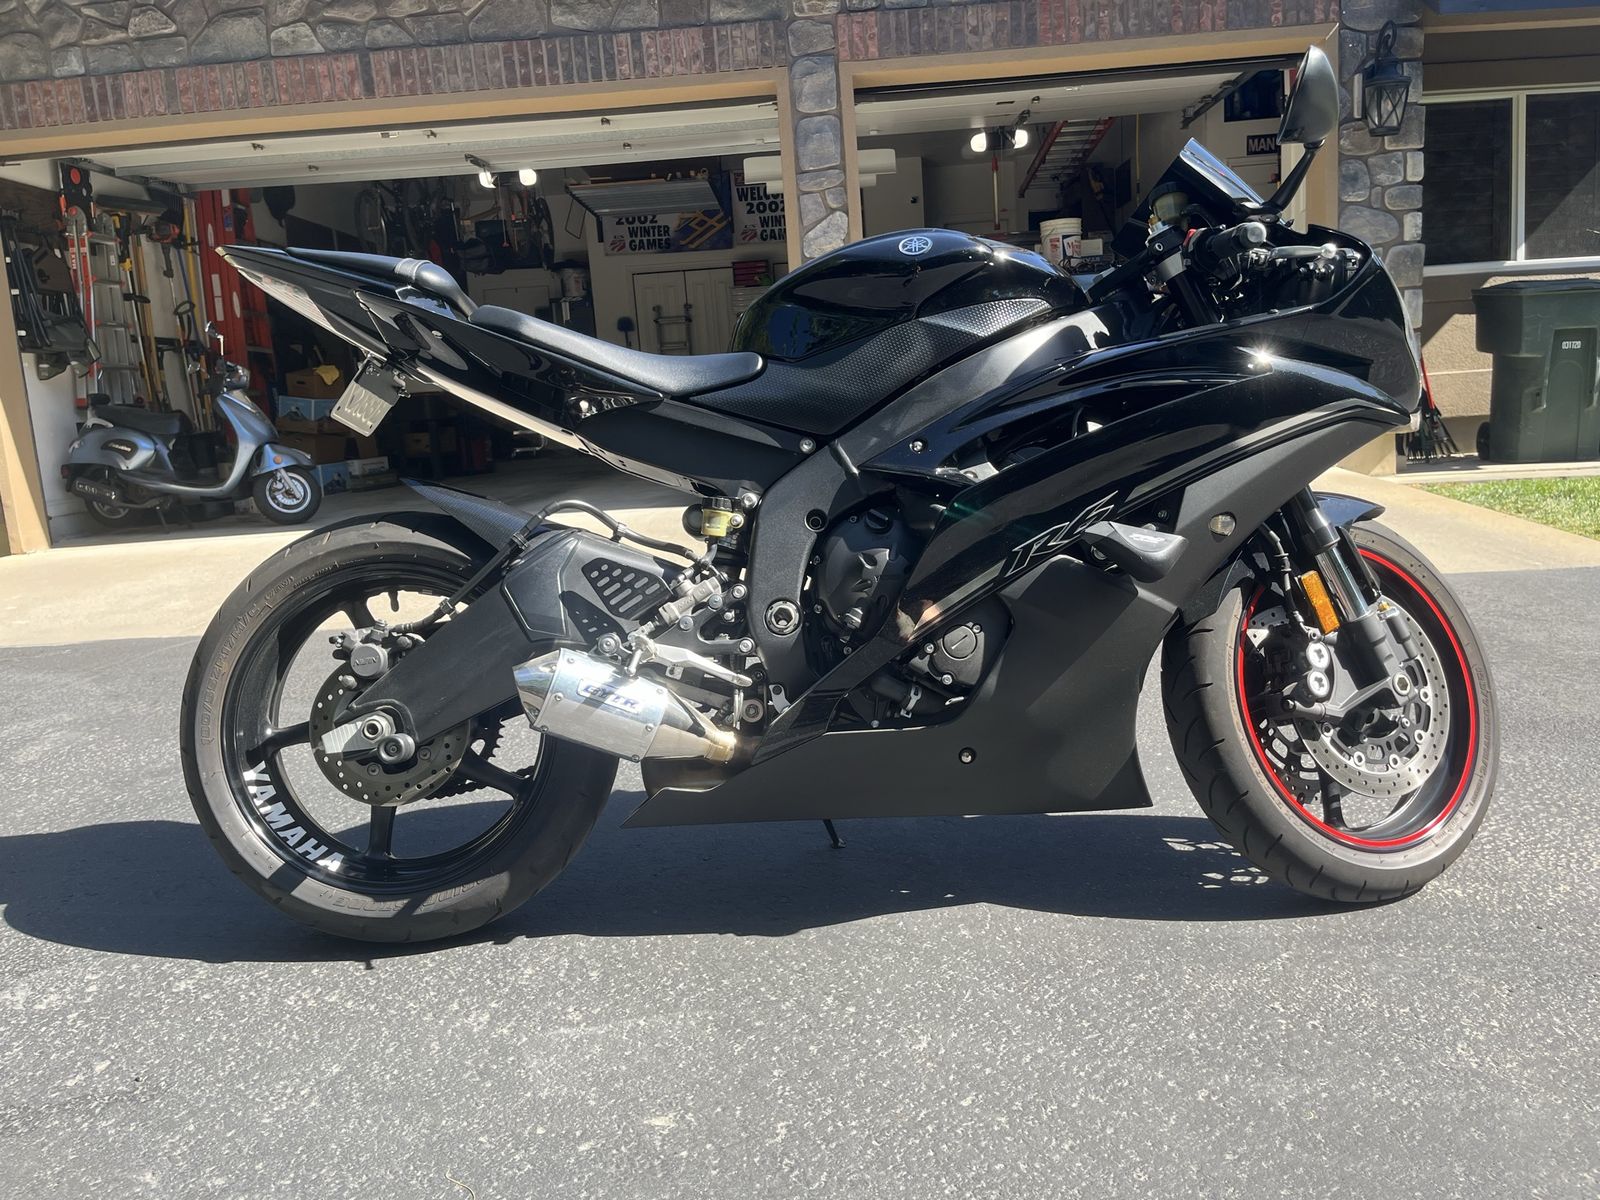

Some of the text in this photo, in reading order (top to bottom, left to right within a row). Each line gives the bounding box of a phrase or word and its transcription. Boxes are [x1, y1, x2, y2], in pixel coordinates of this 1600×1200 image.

[1248, 137, 1275, 152] MAN
[615, 214, 658, 225] 2002
[628, 225, 671, 238] WINTER
[628, 237, 671, 251] GAMES
[242, 760, 345, 872] YAMAHA
